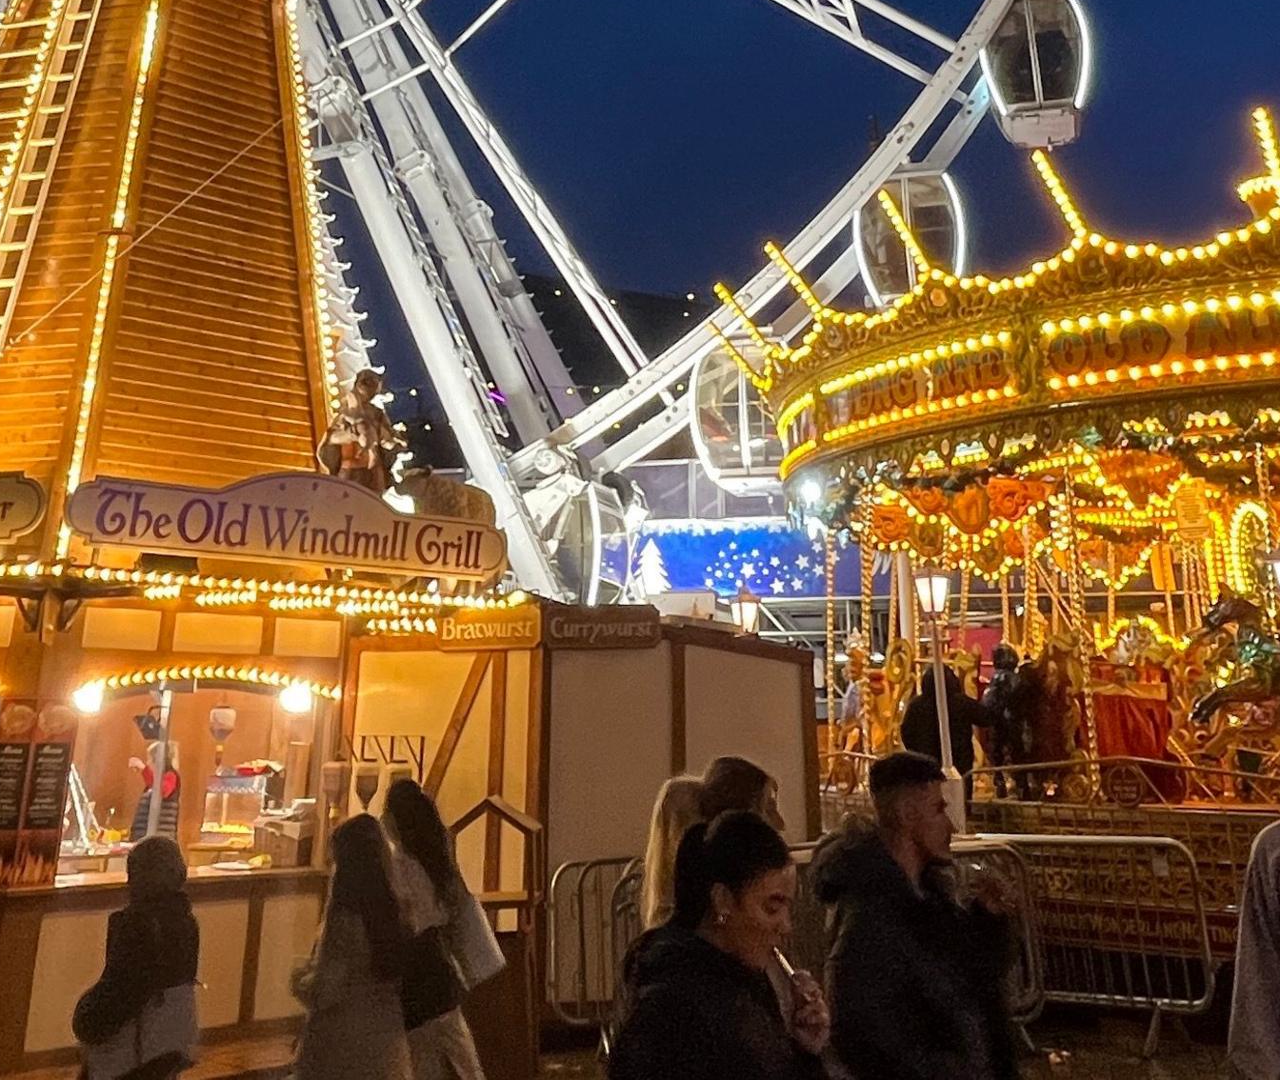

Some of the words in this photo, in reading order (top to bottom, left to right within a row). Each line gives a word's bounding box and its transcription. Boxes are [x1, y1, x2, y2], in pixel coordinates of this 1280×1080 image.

[930, 347, 1009, 399] AND
[1048, 320, 1169, 375] OLD
[95, 487, 173, 540] The
[176, 498, 253, 548] Old
[258, 504, 411, 562] Windmill
[415, 523, 484, 570] Grill
[441, 615, 534, 641] Bratwurst
[549, 619, 653, 644] Currywurst
